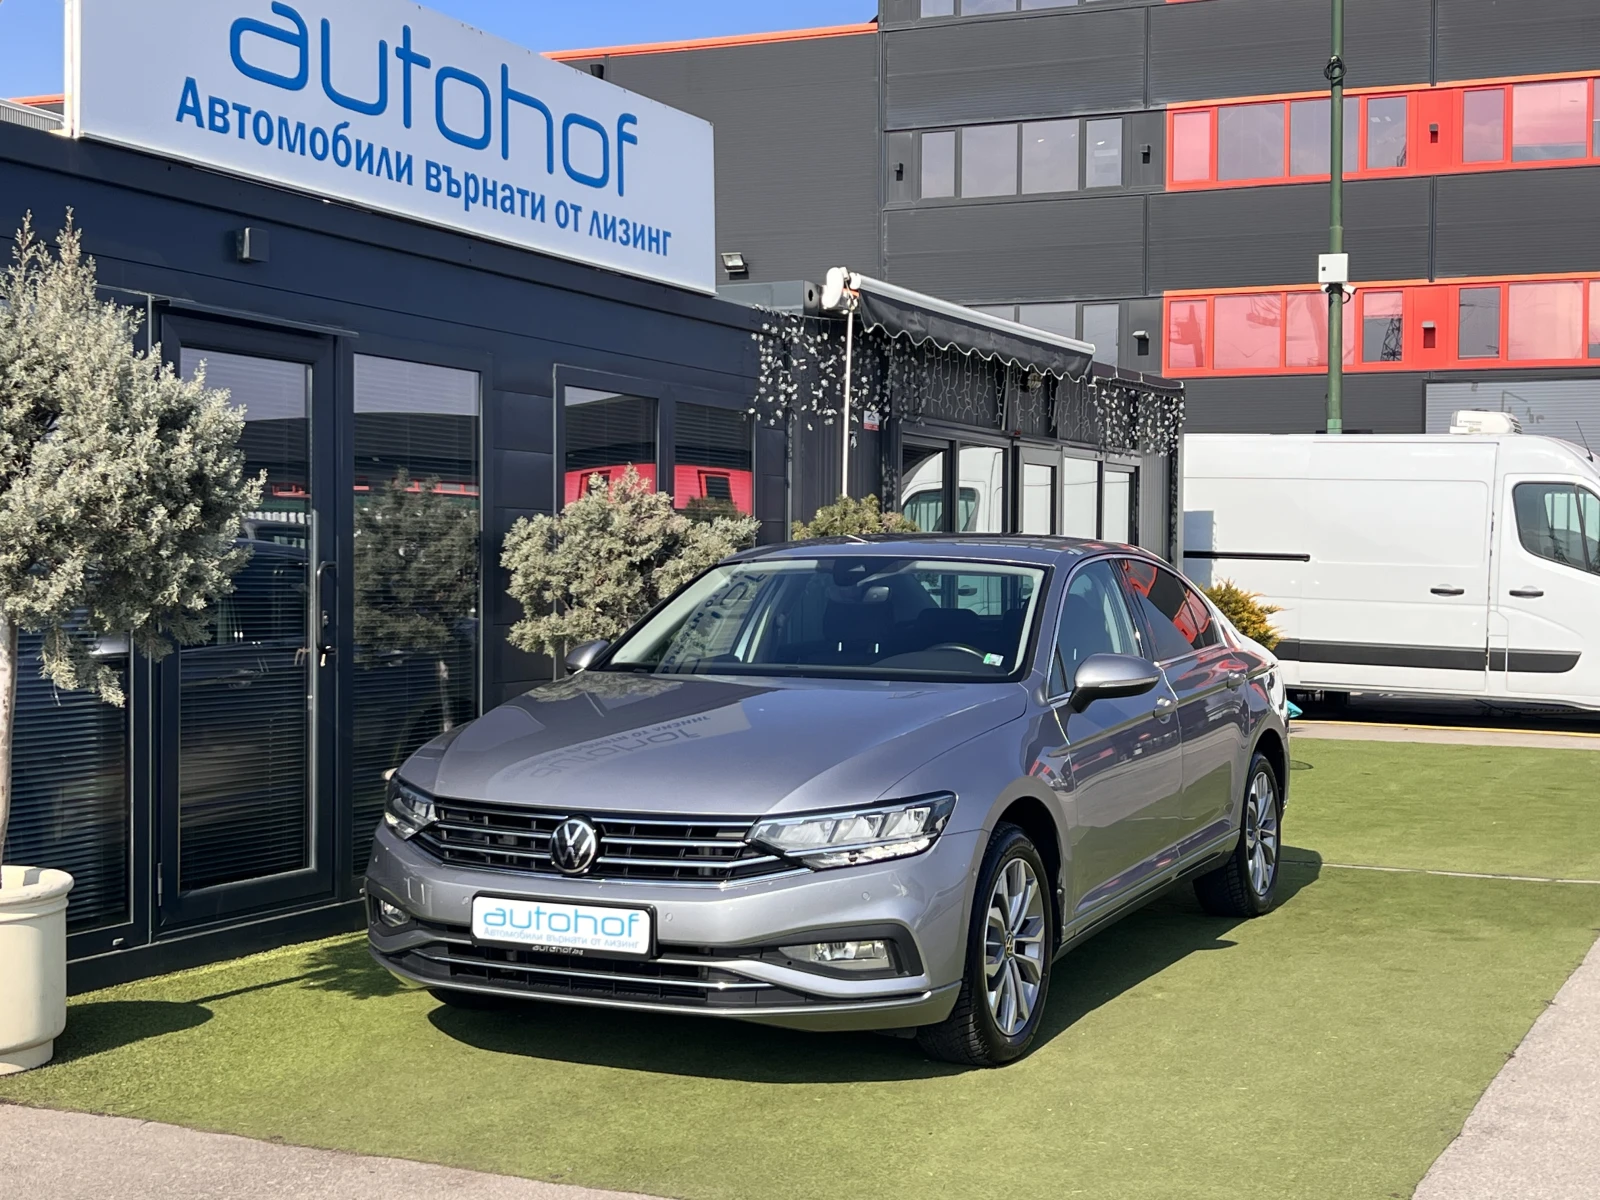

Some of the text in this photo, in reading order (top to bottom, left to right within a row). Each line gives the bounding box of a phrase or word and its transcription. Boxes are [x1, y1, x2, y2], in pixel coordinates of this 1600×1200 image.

[228, 1, 638, 197] autohof
[175, 76, 672, 256] Автомобили върнати от лизинг
[483, 906, 639, 938] autohof
[484, 926, 640, 949] Автомобили върнати от лизинг
